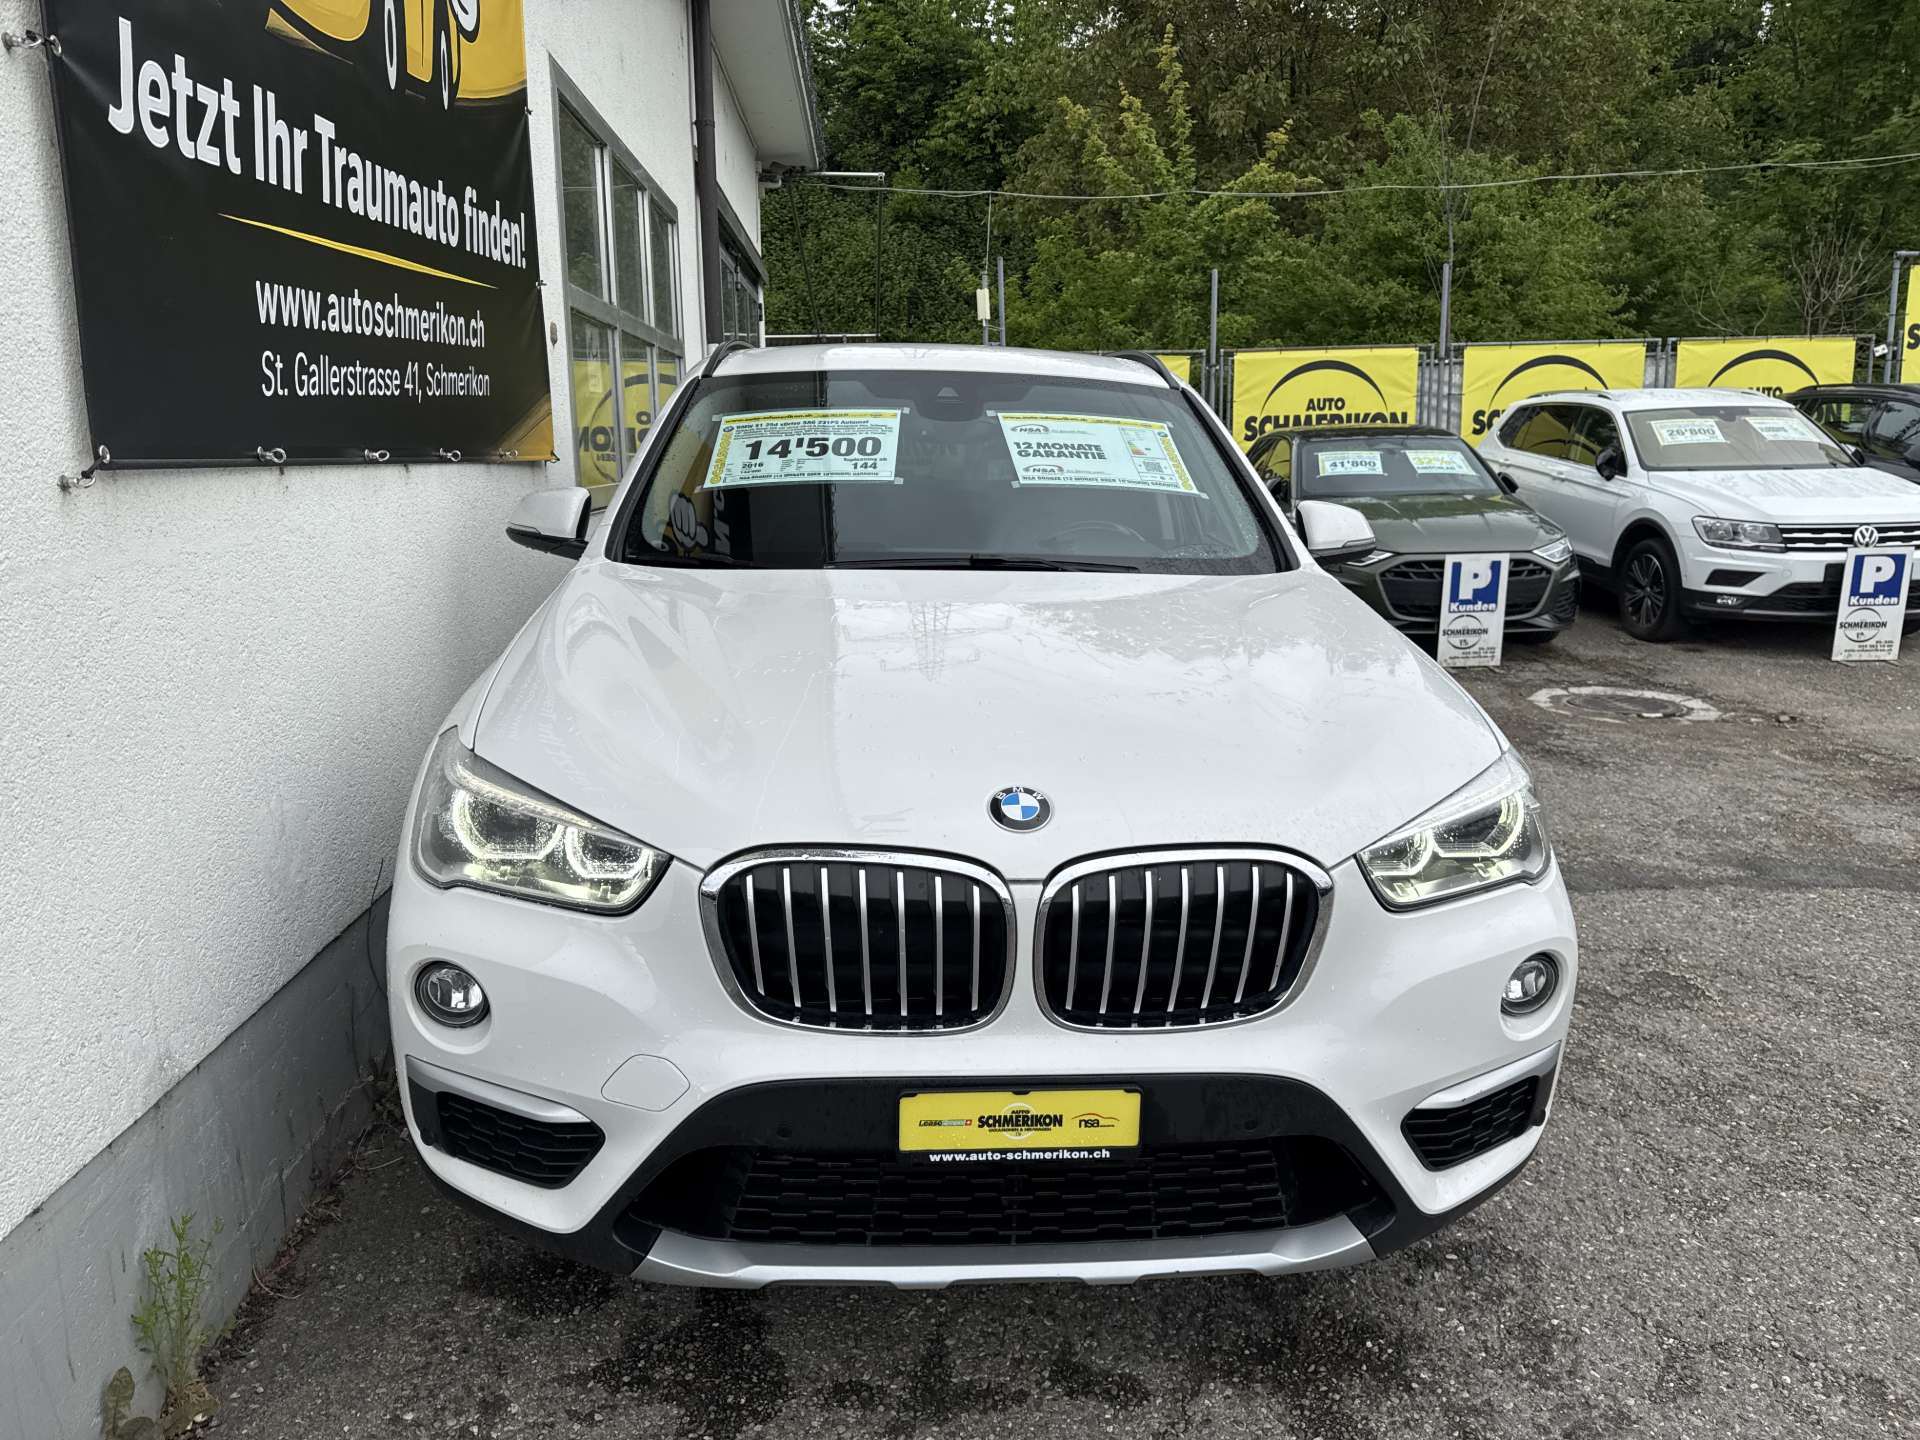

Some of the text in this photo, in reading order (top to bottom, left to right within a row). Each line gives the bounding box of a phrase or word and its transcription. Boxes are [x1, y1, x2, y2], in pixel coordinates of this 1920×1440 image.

[108, 16, 526, 269] Jetzt Ihr Traumauto finden!
[255, 280, 485, 348] www.autoschmerikon.ch
[261, 350, 490, 403] St. Gallerstrasse 41, Schmerikon
[1306, 397, 1346, 411] AUTO
[746, 436, 882, 460] 14'500
[1014, 442, 1104, 452] 12 MONATE
[1017, 450, 1107, 460] GARANTIE
[851, 461, 878, 470] 144
[1329, 460, 1376, 468] 41'800
[1459, 560, 1492, 600] P
[1859, 556, 1896, 593] P
[1450, 601, 1496, 612] Kunden
[1850, 595, 1898, 606] Kunden
[978, 1114, 1063, 1128] SCHMERIKON
[1079, 1119, 1100, 1128] nsa
[929, 1149, 1111, 1162] www.auto-schmerikon.ch
